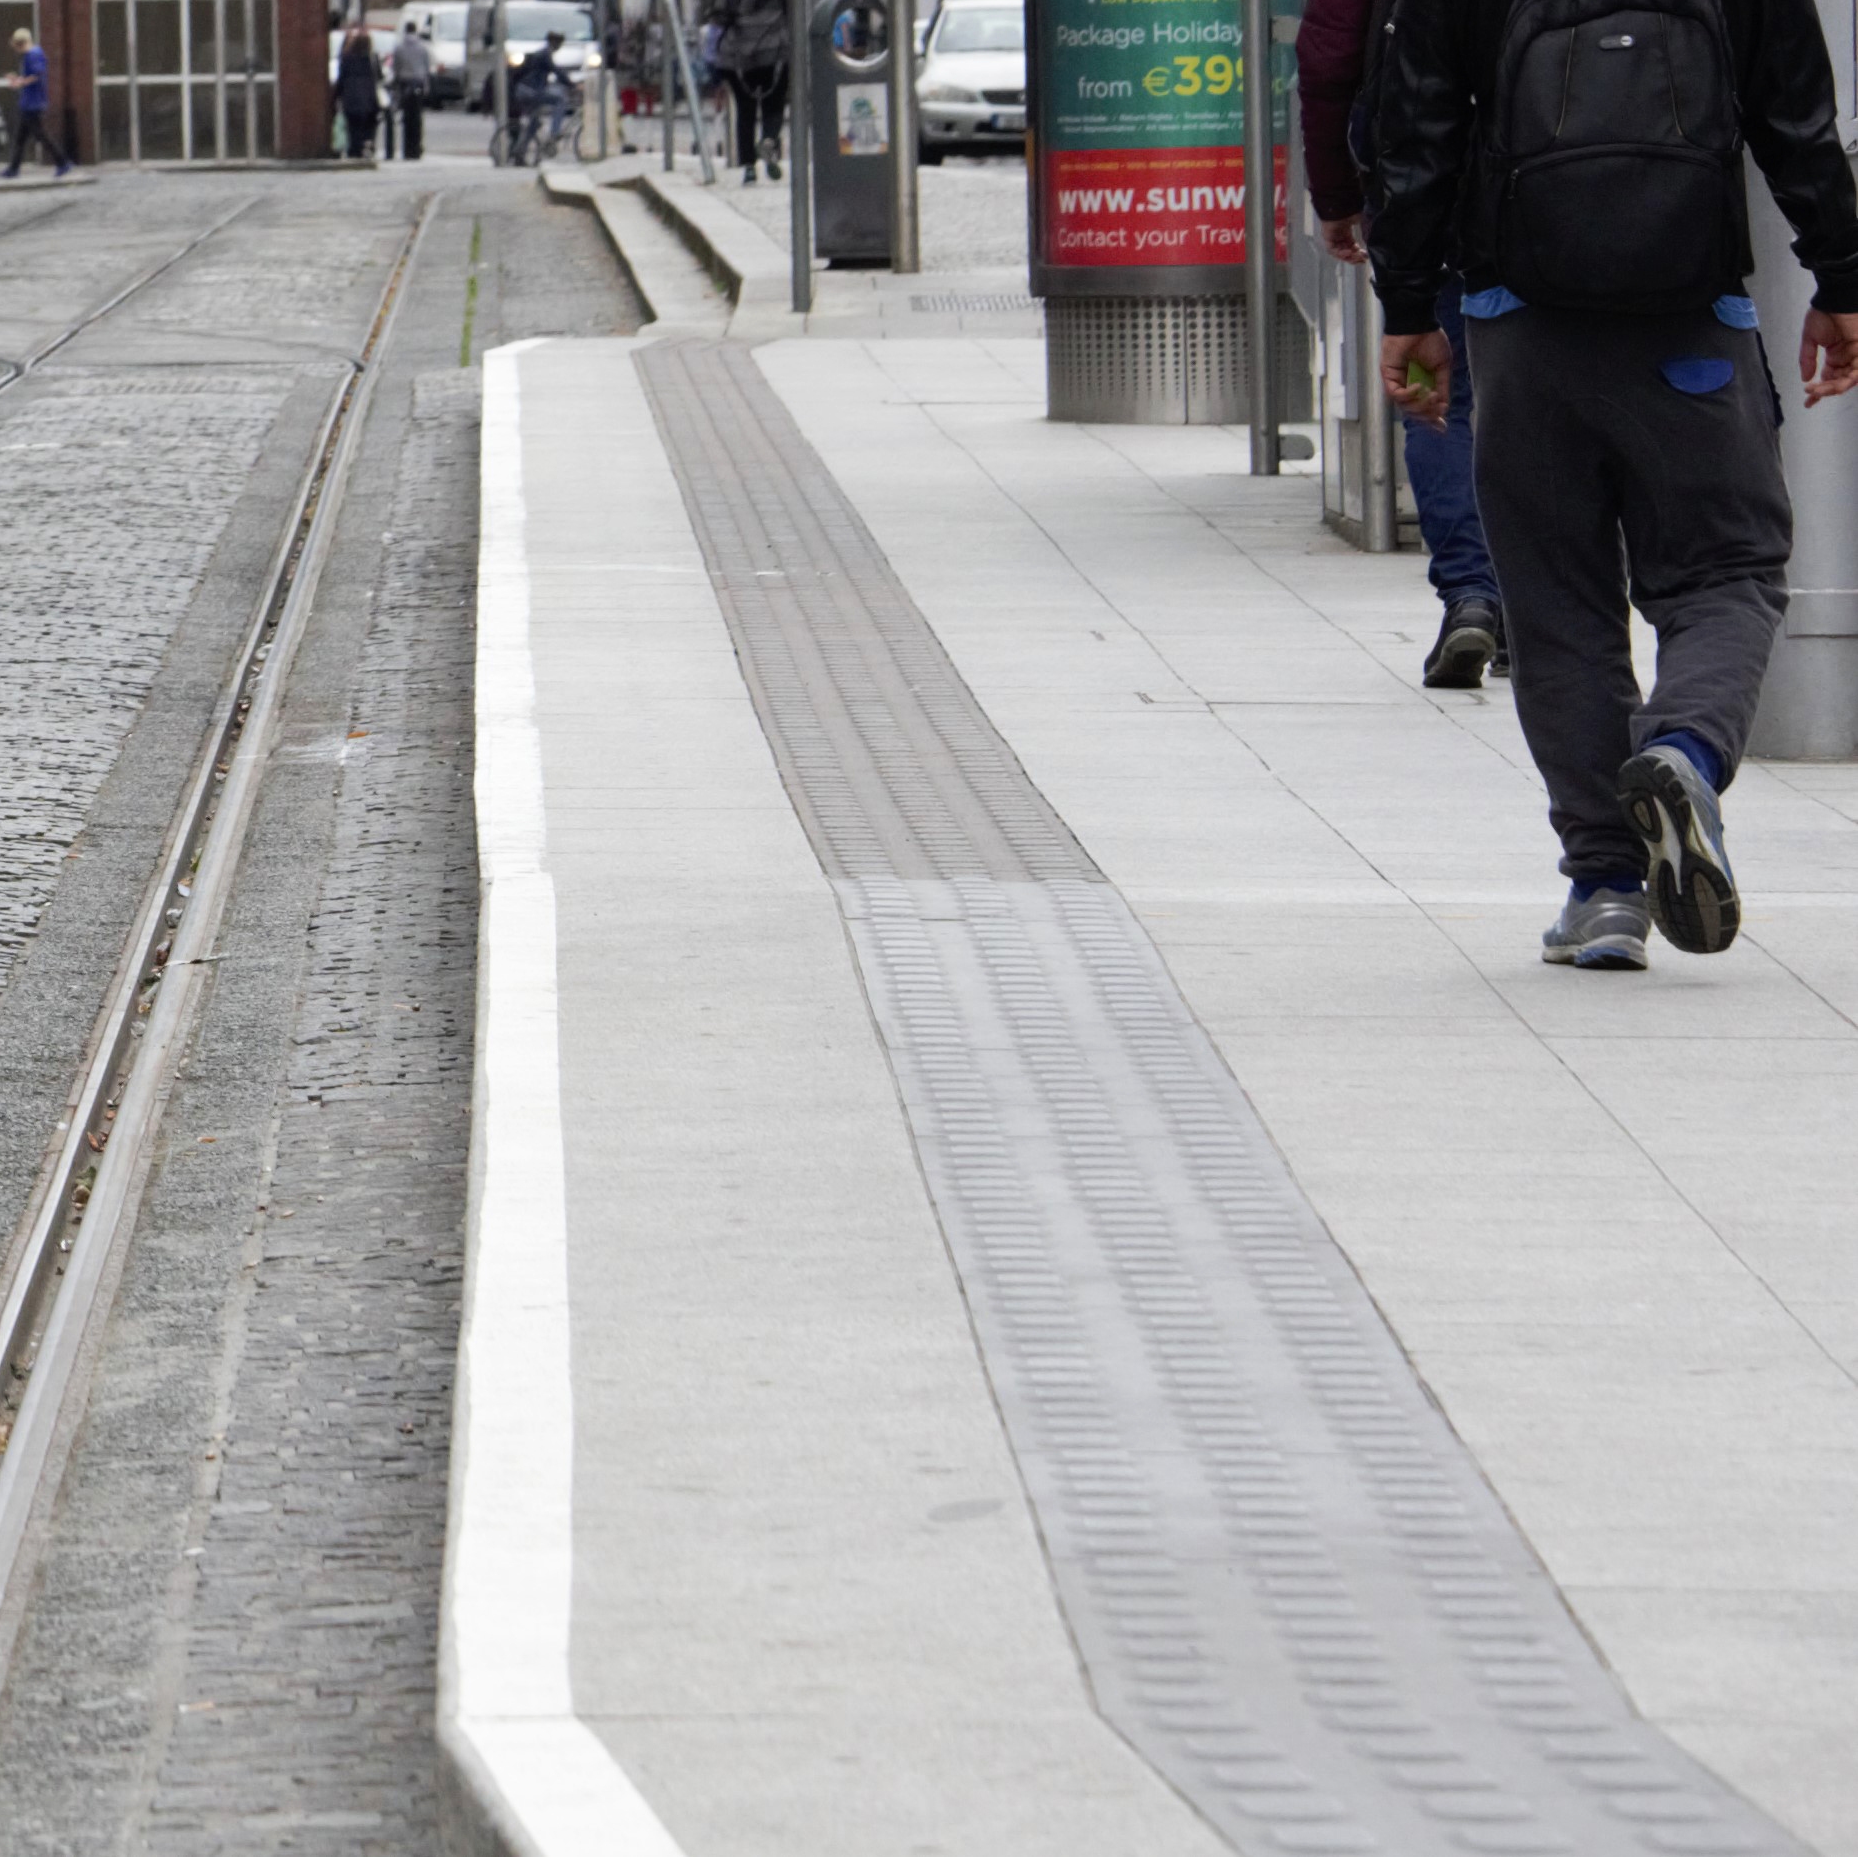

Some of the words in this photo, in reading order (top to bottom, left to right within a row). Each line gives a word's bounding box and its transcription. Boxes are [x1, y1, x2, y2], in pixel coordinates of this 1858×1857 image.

[1057, 24, 1145, 49] Package
[1153, 19, 1243, 46] Holiday
[1078, 76, 1132, 98] from
[1057, 221, 1127, 248] Contact
[1136, 227, 1188, 250] your
[1196, 225, 1246, 245] Trav
